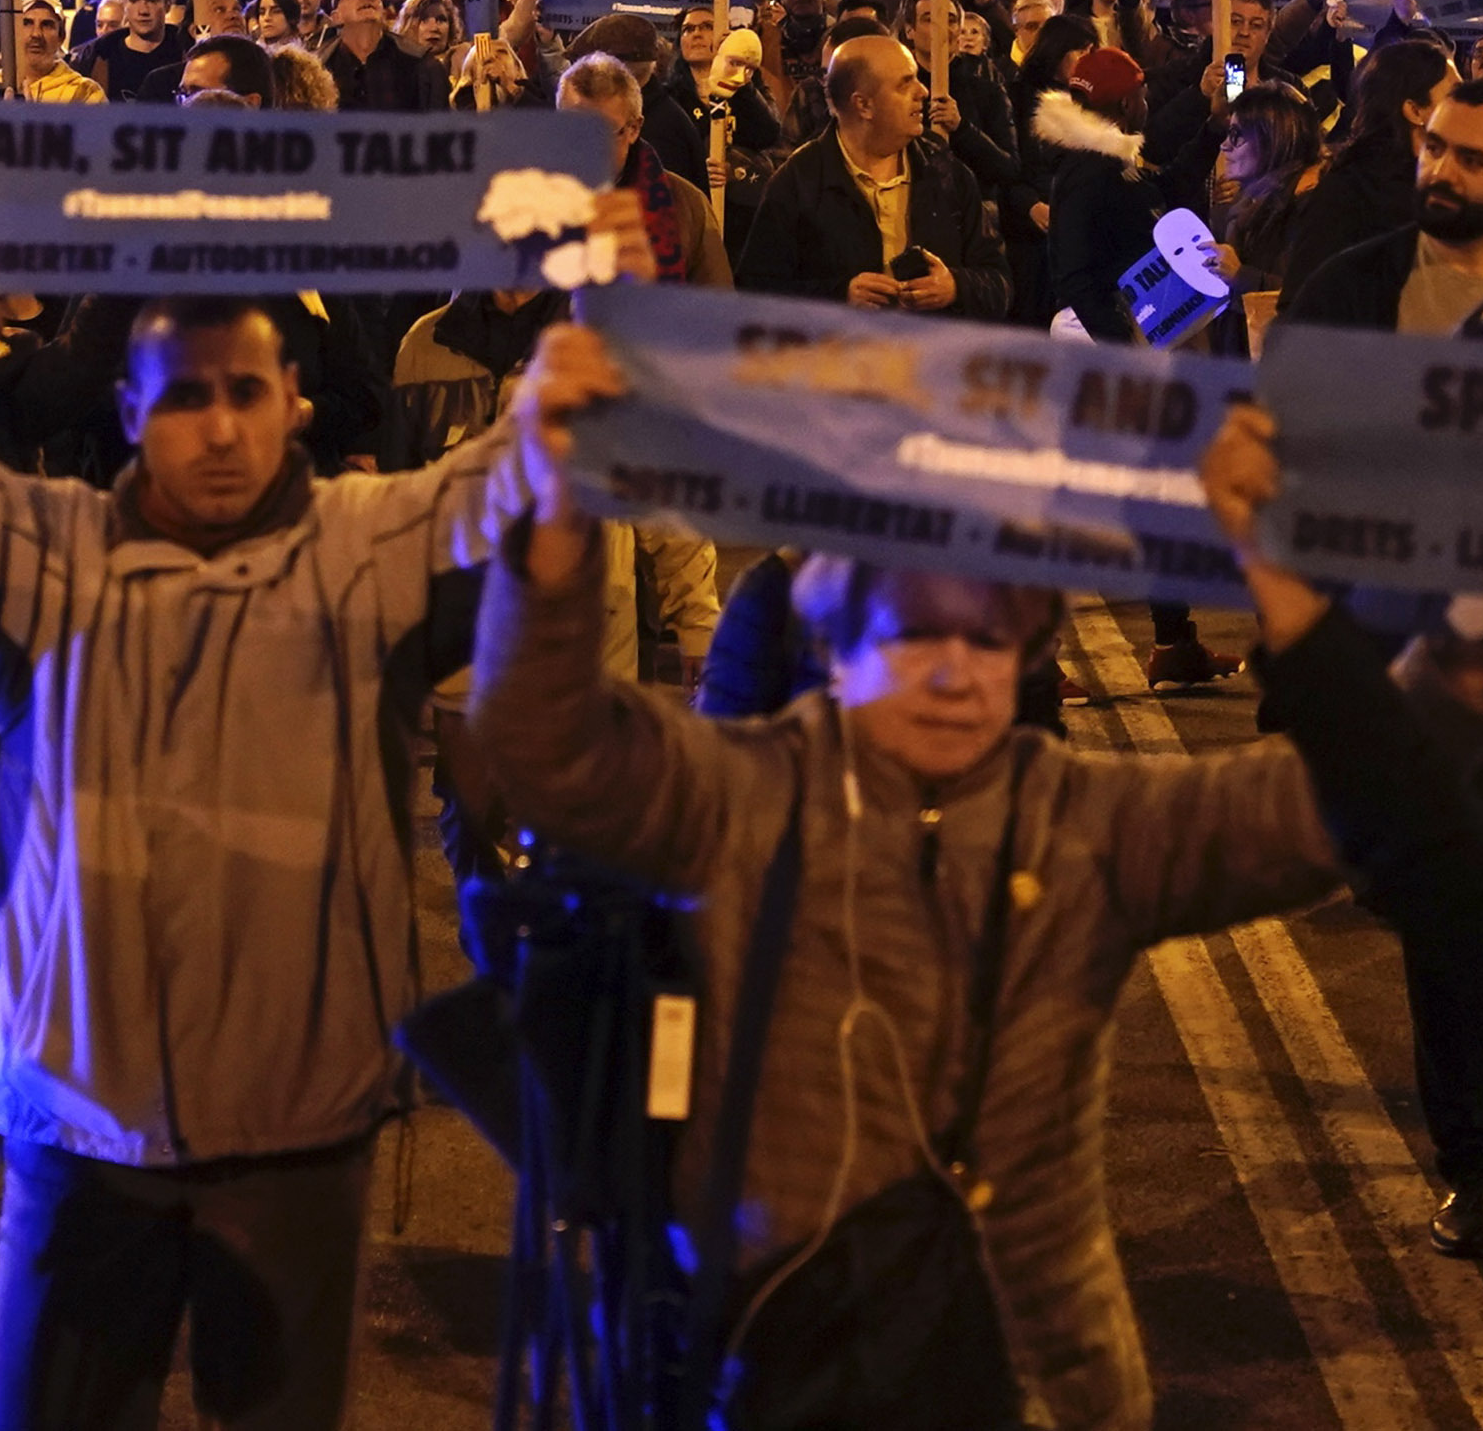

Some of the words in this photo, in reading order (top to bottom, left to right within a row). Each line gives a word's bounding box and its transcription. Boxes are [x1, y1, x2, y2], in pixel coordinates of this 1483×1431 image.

[111, 124, 187, 174] SIT
[205, 126, 316, 175] AND
[335, 129, 477, 176] TALK!
[1069, 368, 1199, 440] AND
